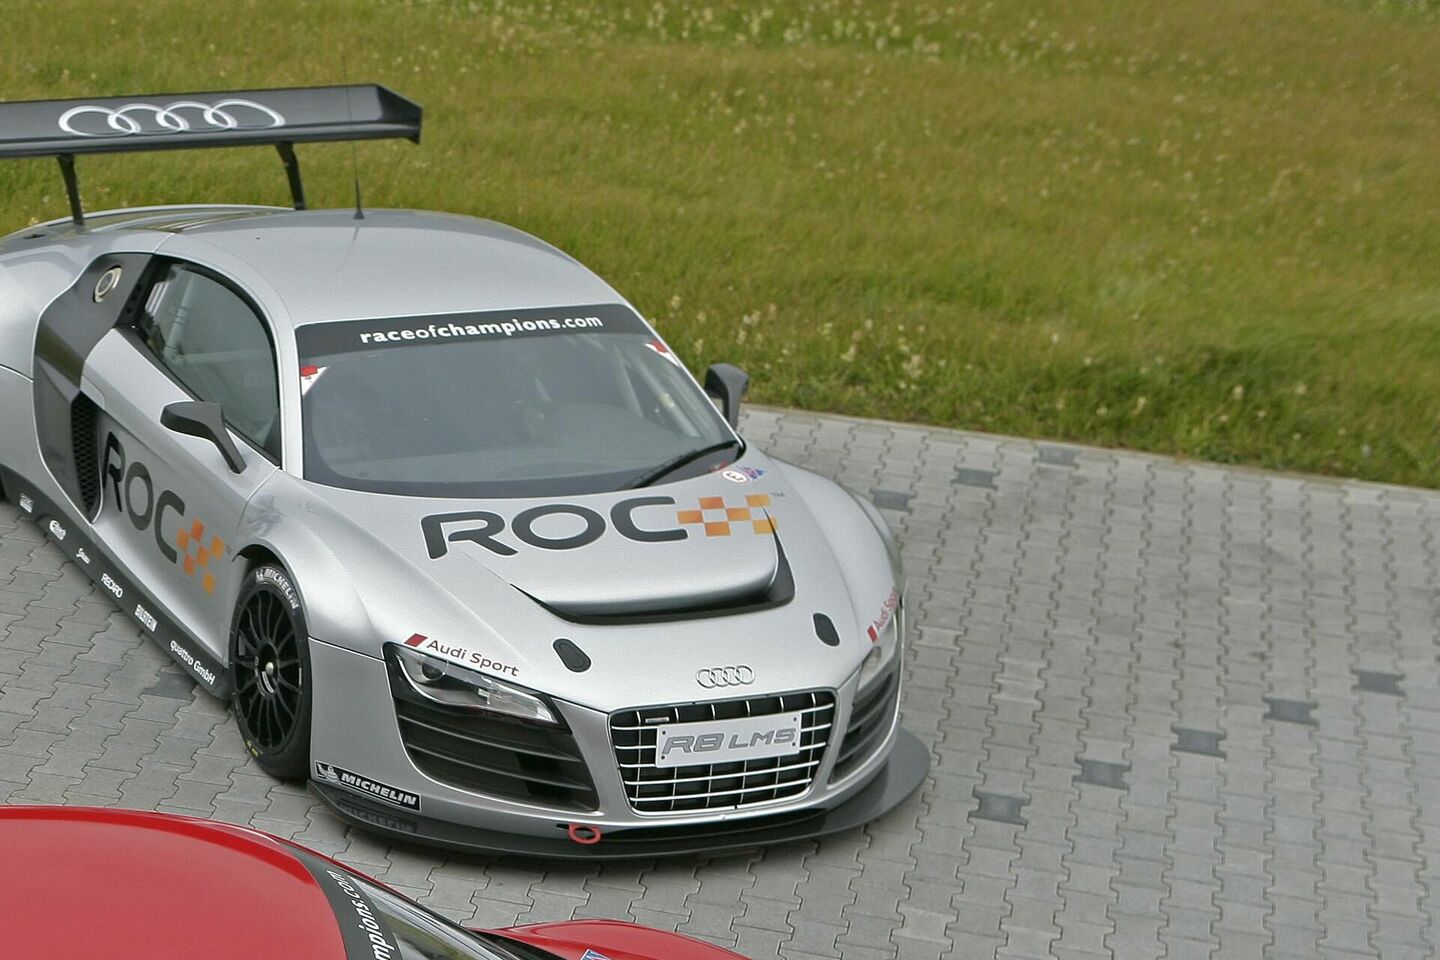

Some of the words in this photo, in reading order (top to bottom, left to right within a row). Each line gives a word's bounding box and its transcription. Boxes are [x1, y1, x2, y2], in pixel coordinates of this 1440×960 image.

[360, 315, 603, 344] raceofchampions.com
[102, 431, 185, 564] ROC
[421, 496, 689, 560] ROC
[170, 640, 194, 665] quattro
[193, 661, 216, 686] GmbH
[427, 639, 467, 660] Audi
[469, 652, 520, 677] Sport
[662, 733, 724, 754] R8
[728, 728, 797, 749] LMS
[341, 772, 417, 805] MICHELIN
